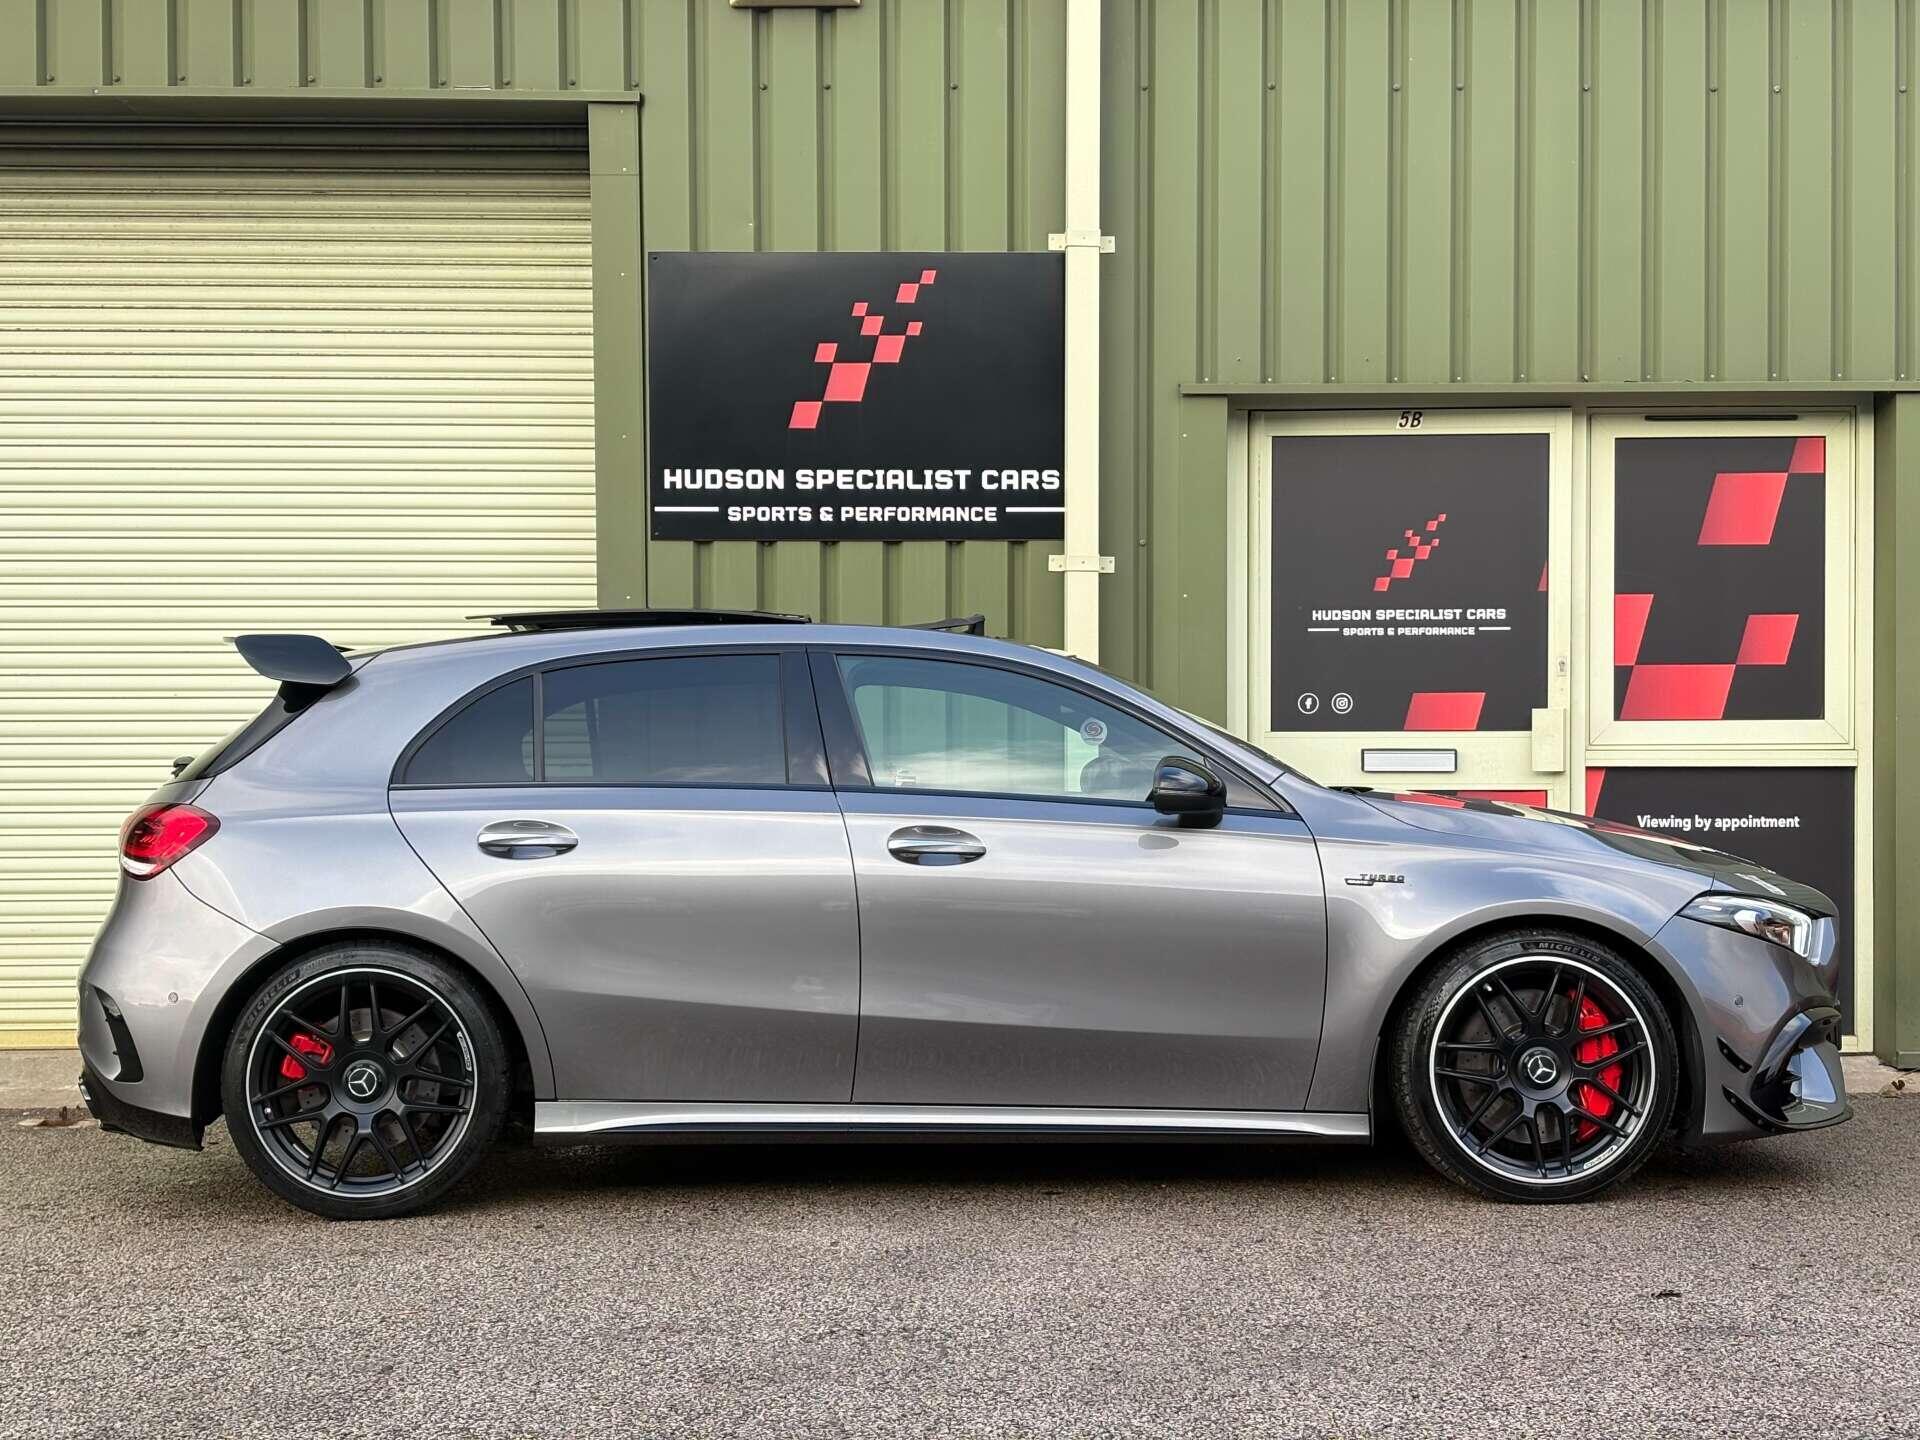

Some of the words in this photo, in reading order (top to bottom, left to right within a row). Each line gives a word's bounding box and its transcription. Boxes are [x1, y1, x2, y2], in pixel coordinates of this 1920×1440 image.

[1399, 410, 1423, 428] 5B
[663, 468, 785, 490] HUDSON
[795, 469, 972, 490] SPECIALIST
[981, 469, 1060, 490] CARS
[727, 506, 813, 522] SPORTS
[819, 506, 834, 522] &
[840, 506, 998, 522] PERFORMANCE
[1311, 609, 1372, 621] HUDSON
[1375, 608, 1463, 621] SPECIALIST
[1466, 608, 1507, 620] CARS
[1342, 627, 1385, 637] SPORTS
[1397, 626, 1476, 636] PERFORMANCE
[1637, 814, 1692, 832] Viewing
[1694, 814, 1713, 832] by
[1714, 814, 1801, 832] appointment
[1359, 873, 1406, 883] TURBO
[1538, 942, 1601, 962] MICHELIN
